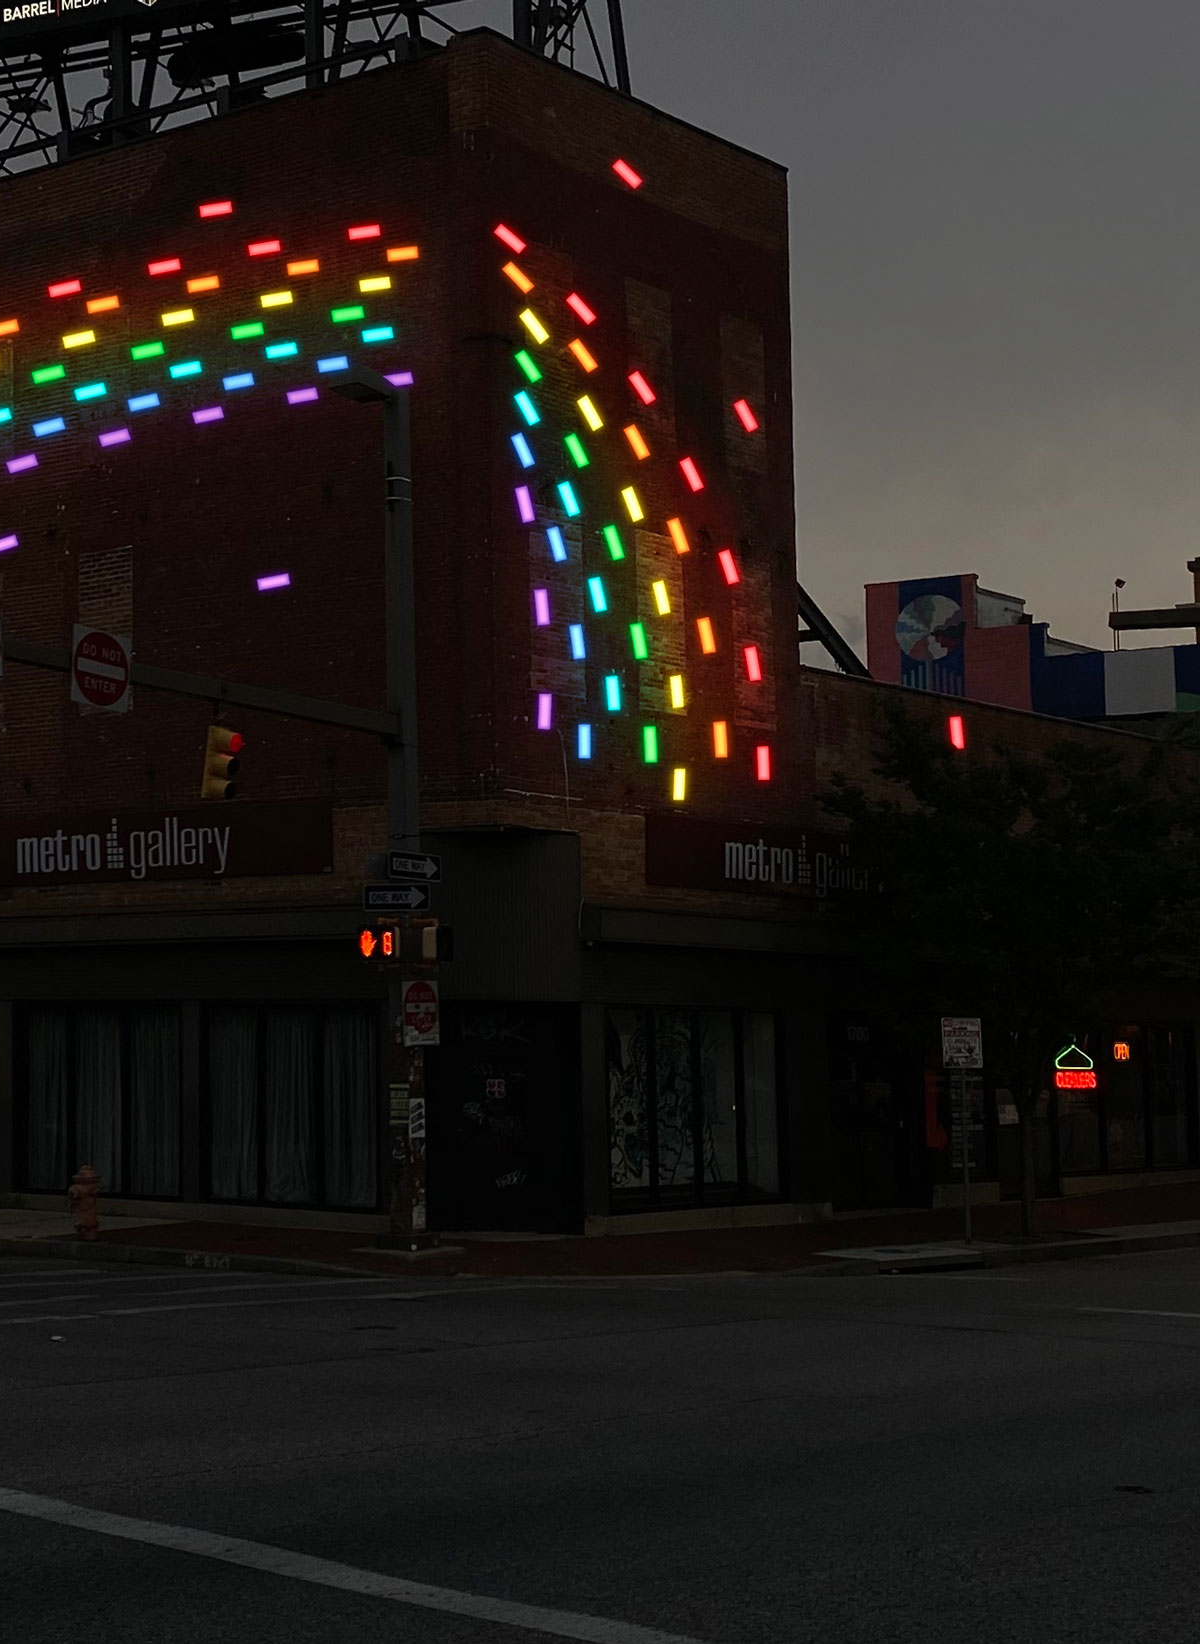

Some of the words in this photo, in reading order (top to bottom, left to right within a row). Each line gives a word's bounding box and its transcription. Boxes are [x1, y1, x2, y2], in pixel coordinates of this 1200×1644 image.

[3, 1, 55, 22] BARREL
[82, 643, 97, 656] DO
[102, 647, 122, 662] NOT
[84, 676, 118, 695] ENTER
[16, 829, 100, 873] metro
[129, 817, 231, 879] gallery
[724, 838, 793, 884] metro
[371, 893, 389, 902] ONE
[392, 893, 410, 902] WAY
